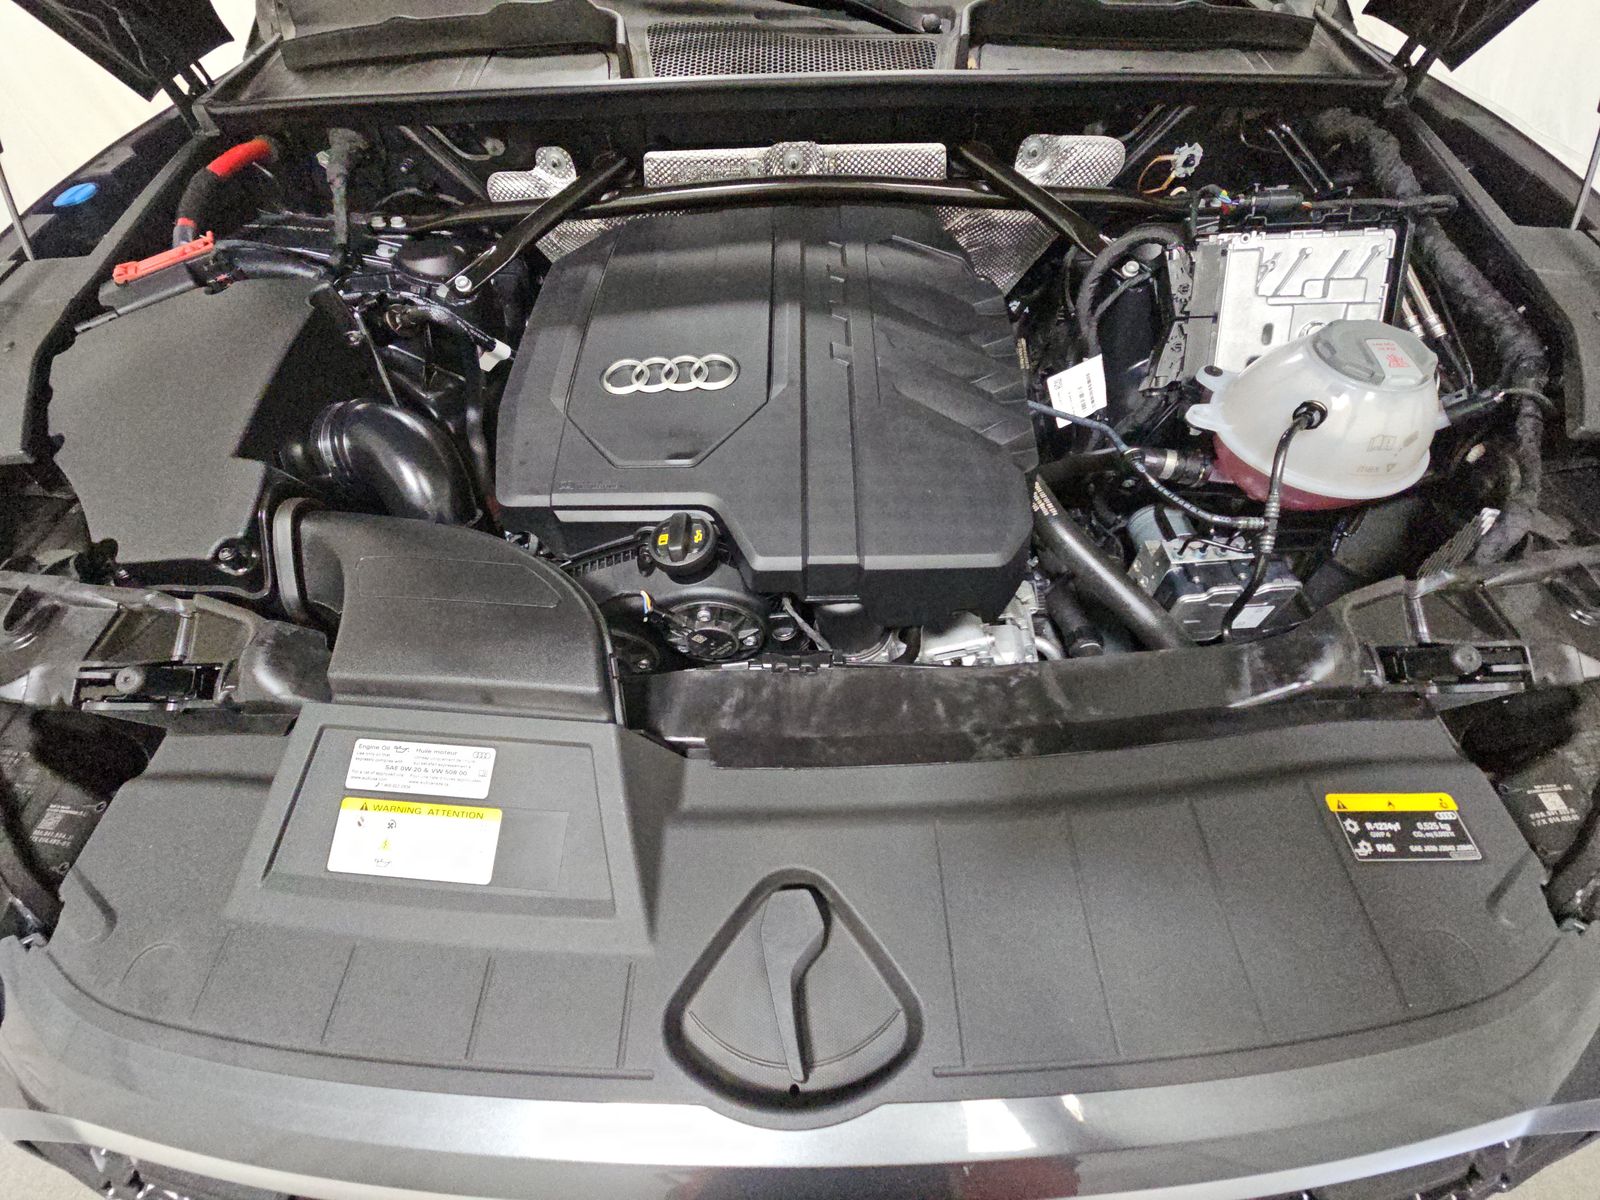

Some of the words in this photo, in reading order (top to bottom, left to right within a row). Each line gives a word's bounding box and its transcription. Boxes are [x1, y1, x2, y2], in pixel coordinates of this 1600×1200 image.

[358, 743, 380, 751] Engine
[373, 803, 422, 815] WARNING
[427, 808, 484, 820] ATTENTION
[1365, 822, 1401, 831] R-1234yf
[1375, 844, 1396, 852] PAG
